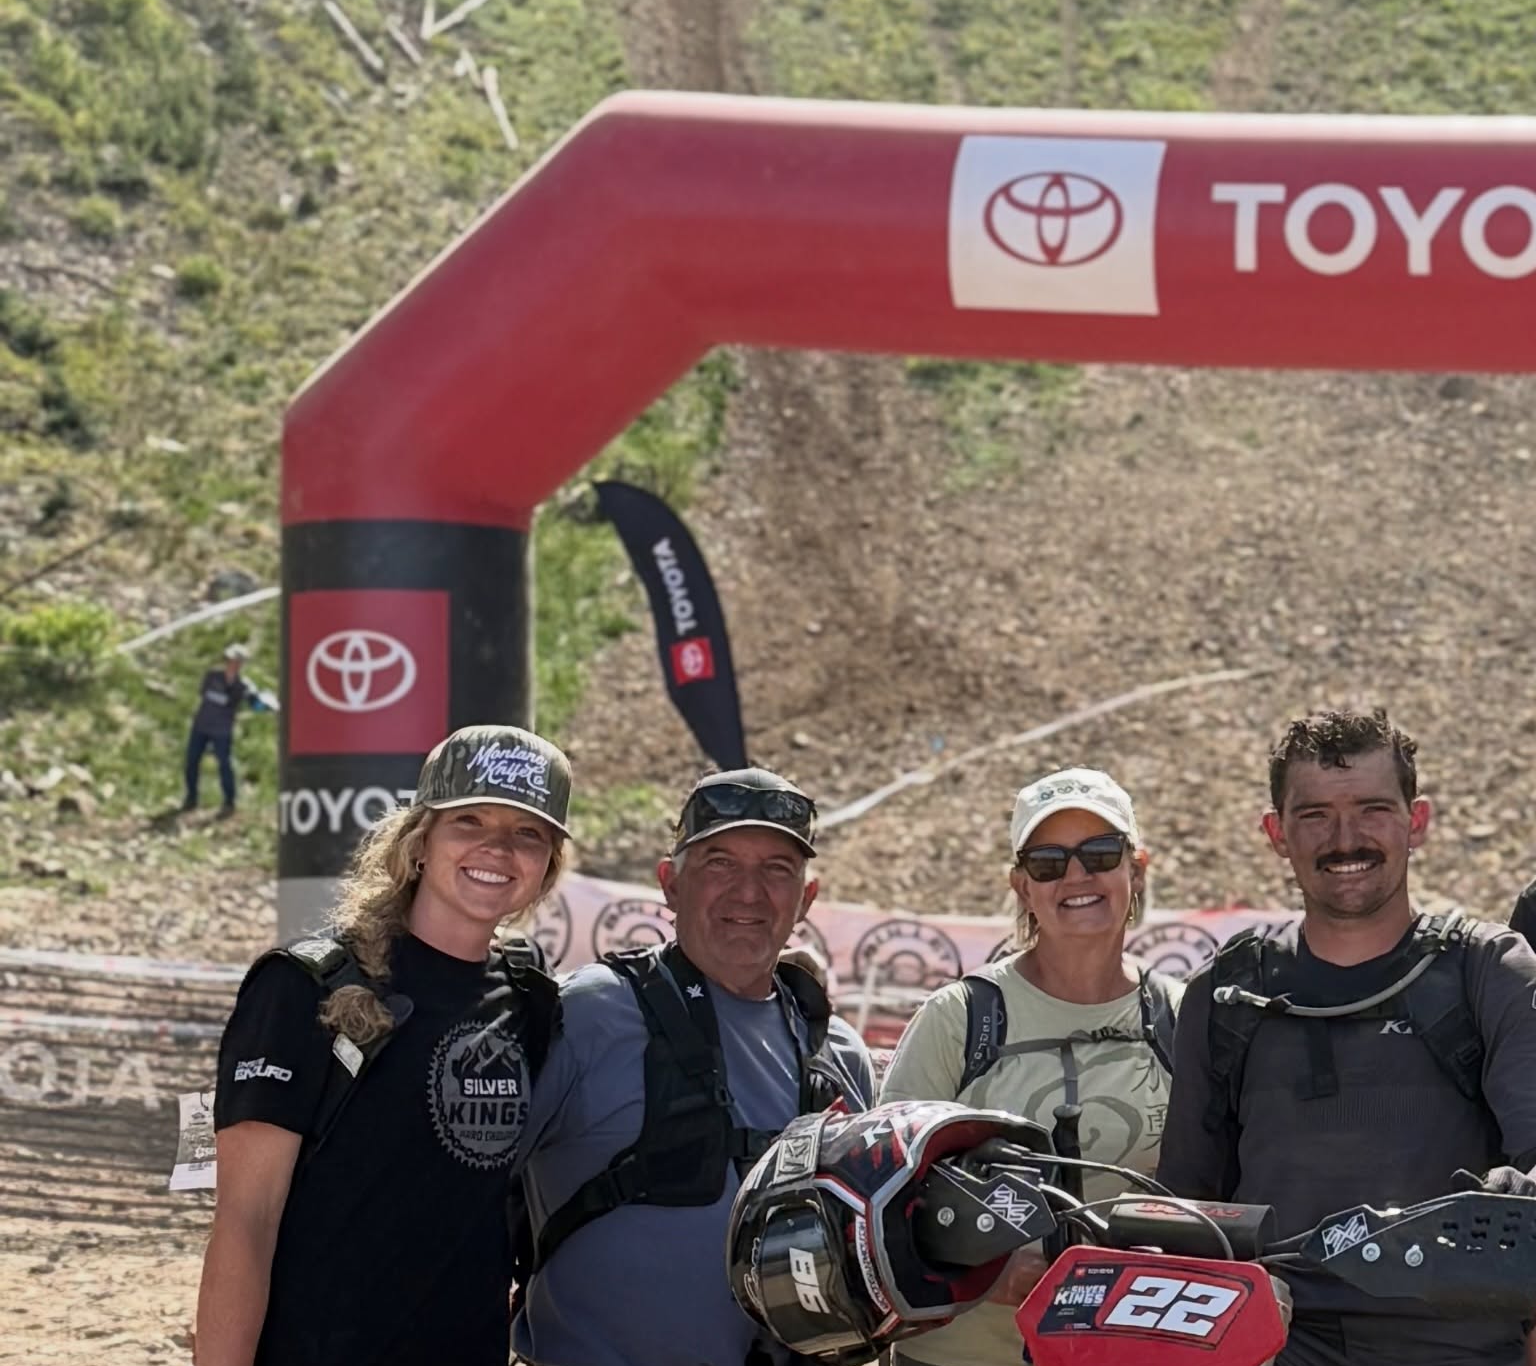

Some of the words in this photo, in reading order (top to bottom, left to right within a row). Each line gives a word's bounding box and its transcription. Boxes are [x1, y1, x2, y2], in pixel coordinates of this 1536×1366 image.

[652, 537, 698, 636] TOYOTA
[466, 741, 548, 772] Montana
[474, 760, 528, 785] Knife
[279, 786, 418, 834] TOYO
[463, 1078, 519, 1096] SILVER
[449, 1101, 529, 1126] KINGS
[1053, 1290, 1106, 1305] KINGS
[1103, 1275, 1241, 1337] 22
